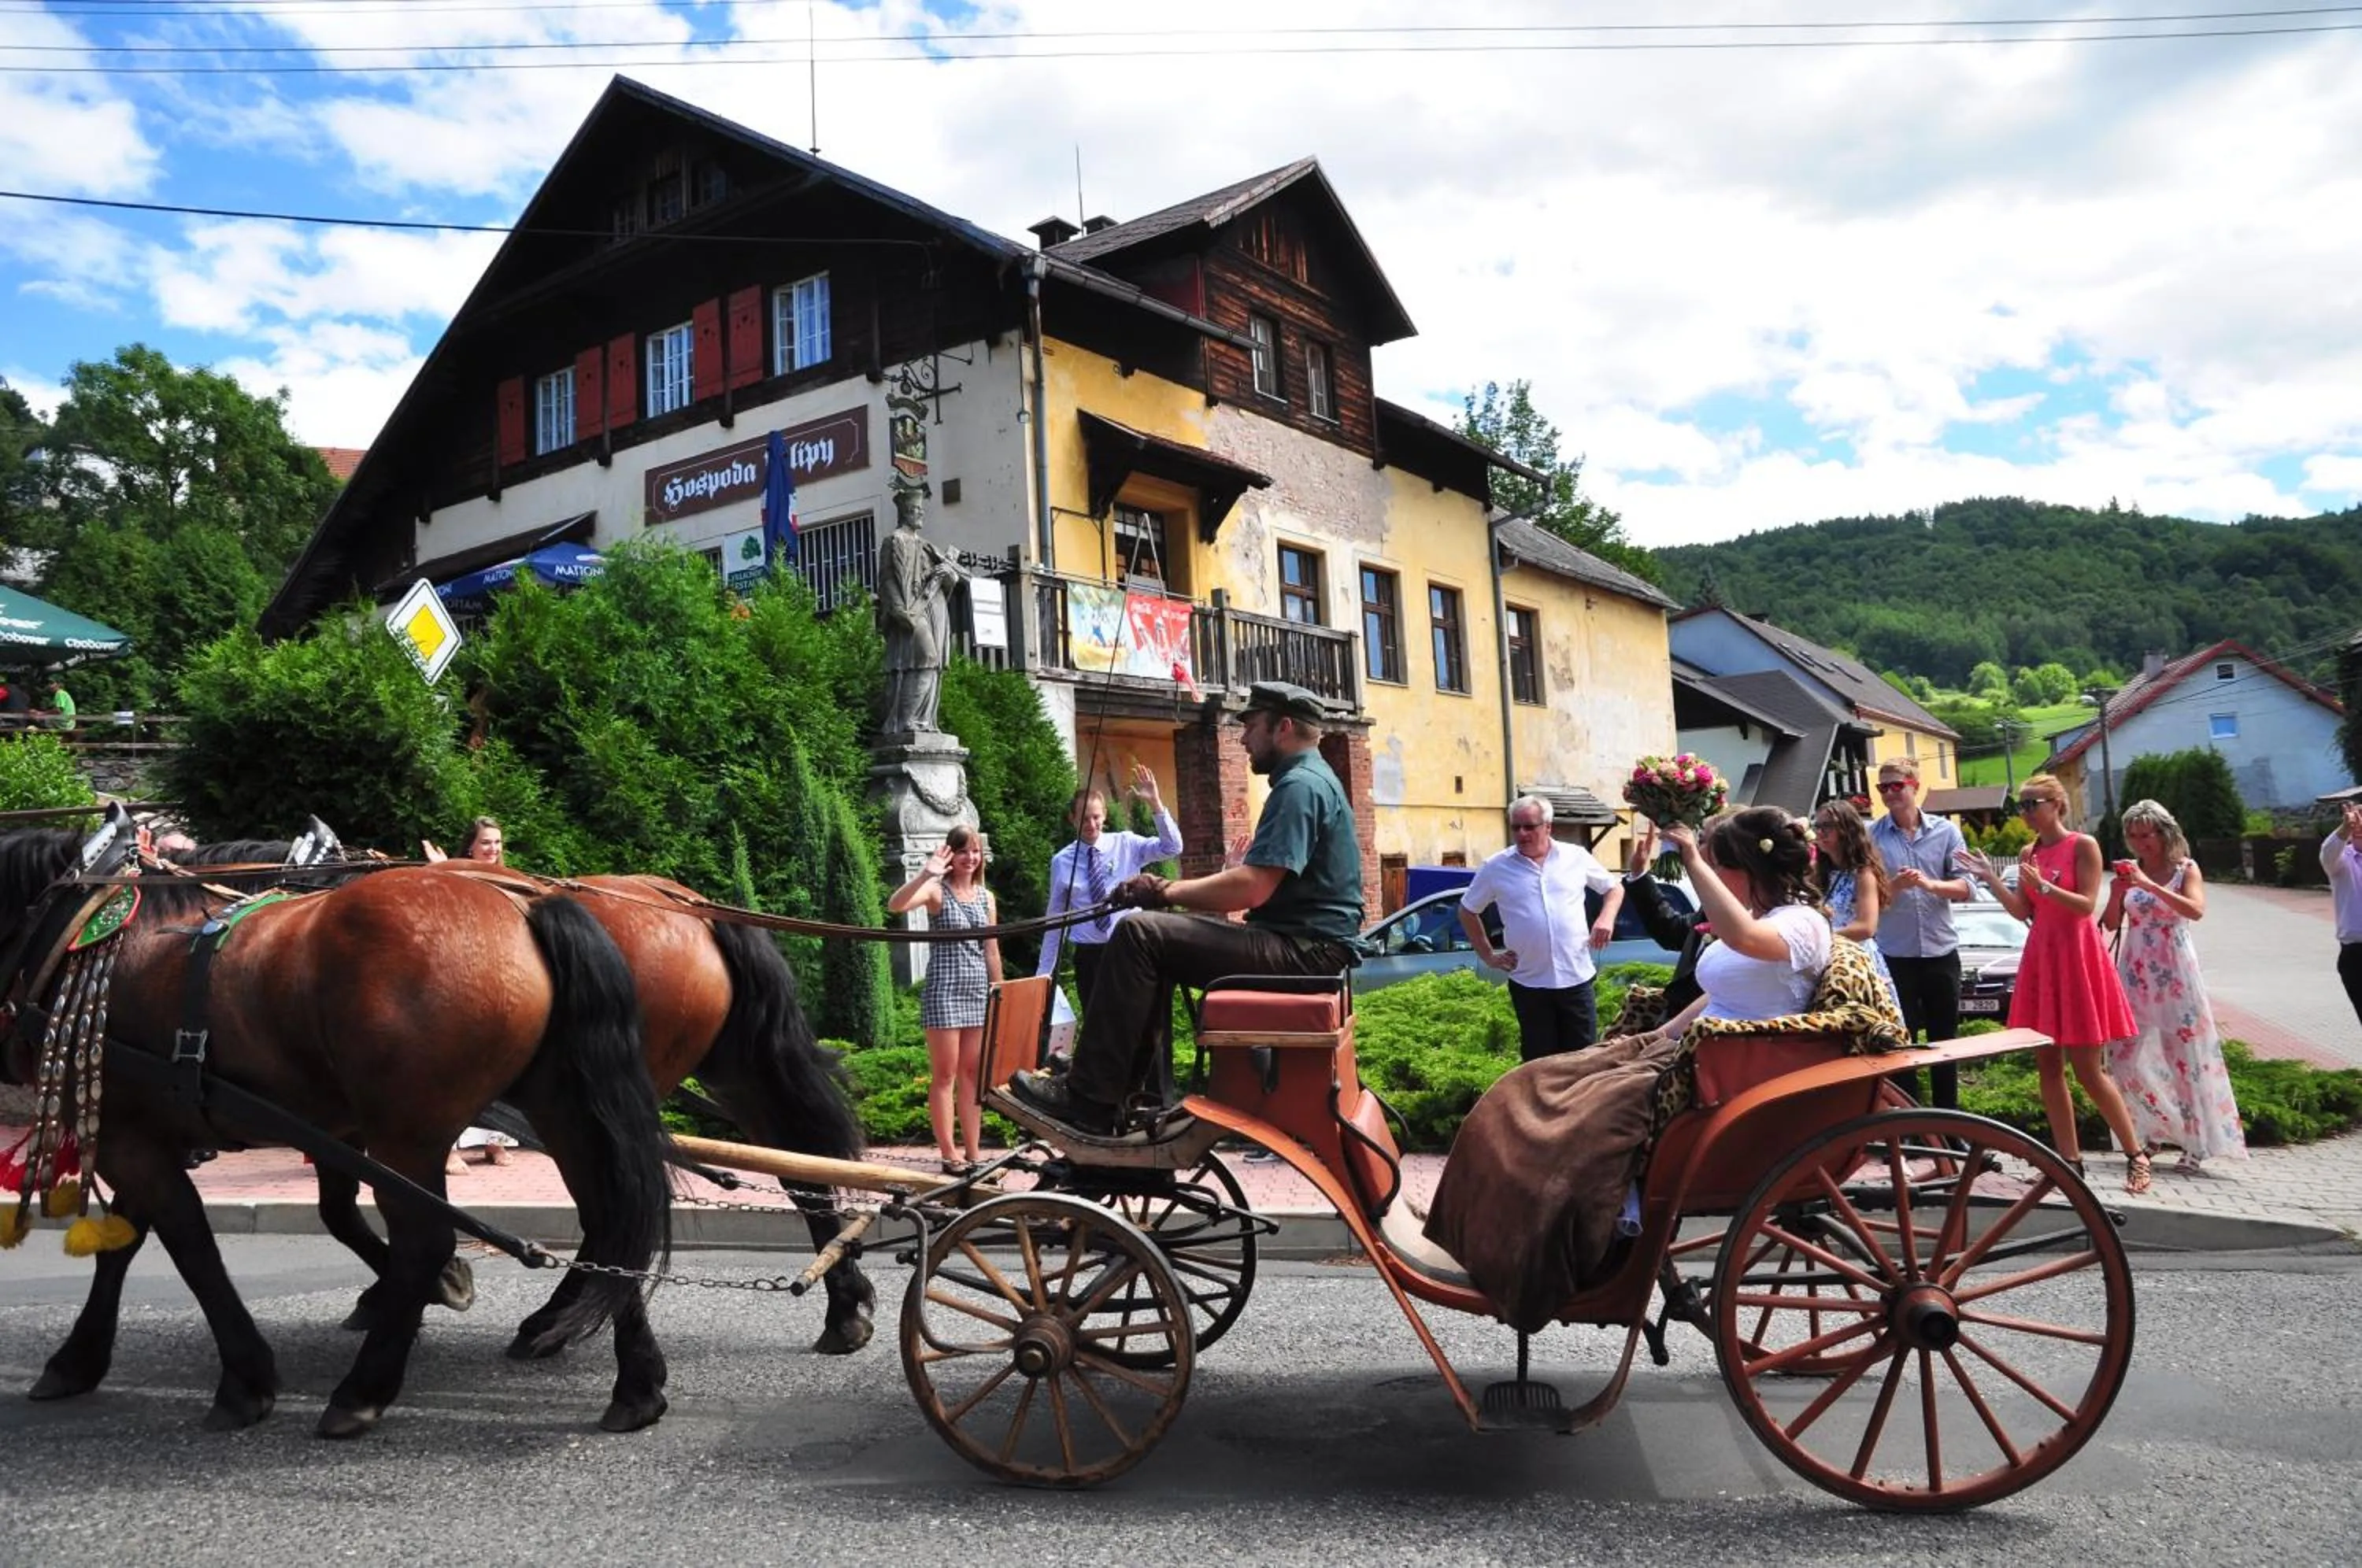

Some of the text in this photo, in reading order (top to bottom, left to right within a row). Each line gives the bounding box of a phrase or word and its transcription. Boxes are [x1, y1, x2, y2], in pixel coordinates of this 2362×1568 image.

[664, 459, 757, 508] Hospoda
[483, 569, 516, 584] MATTON
[554, 564, 605, 577] MATTONI
